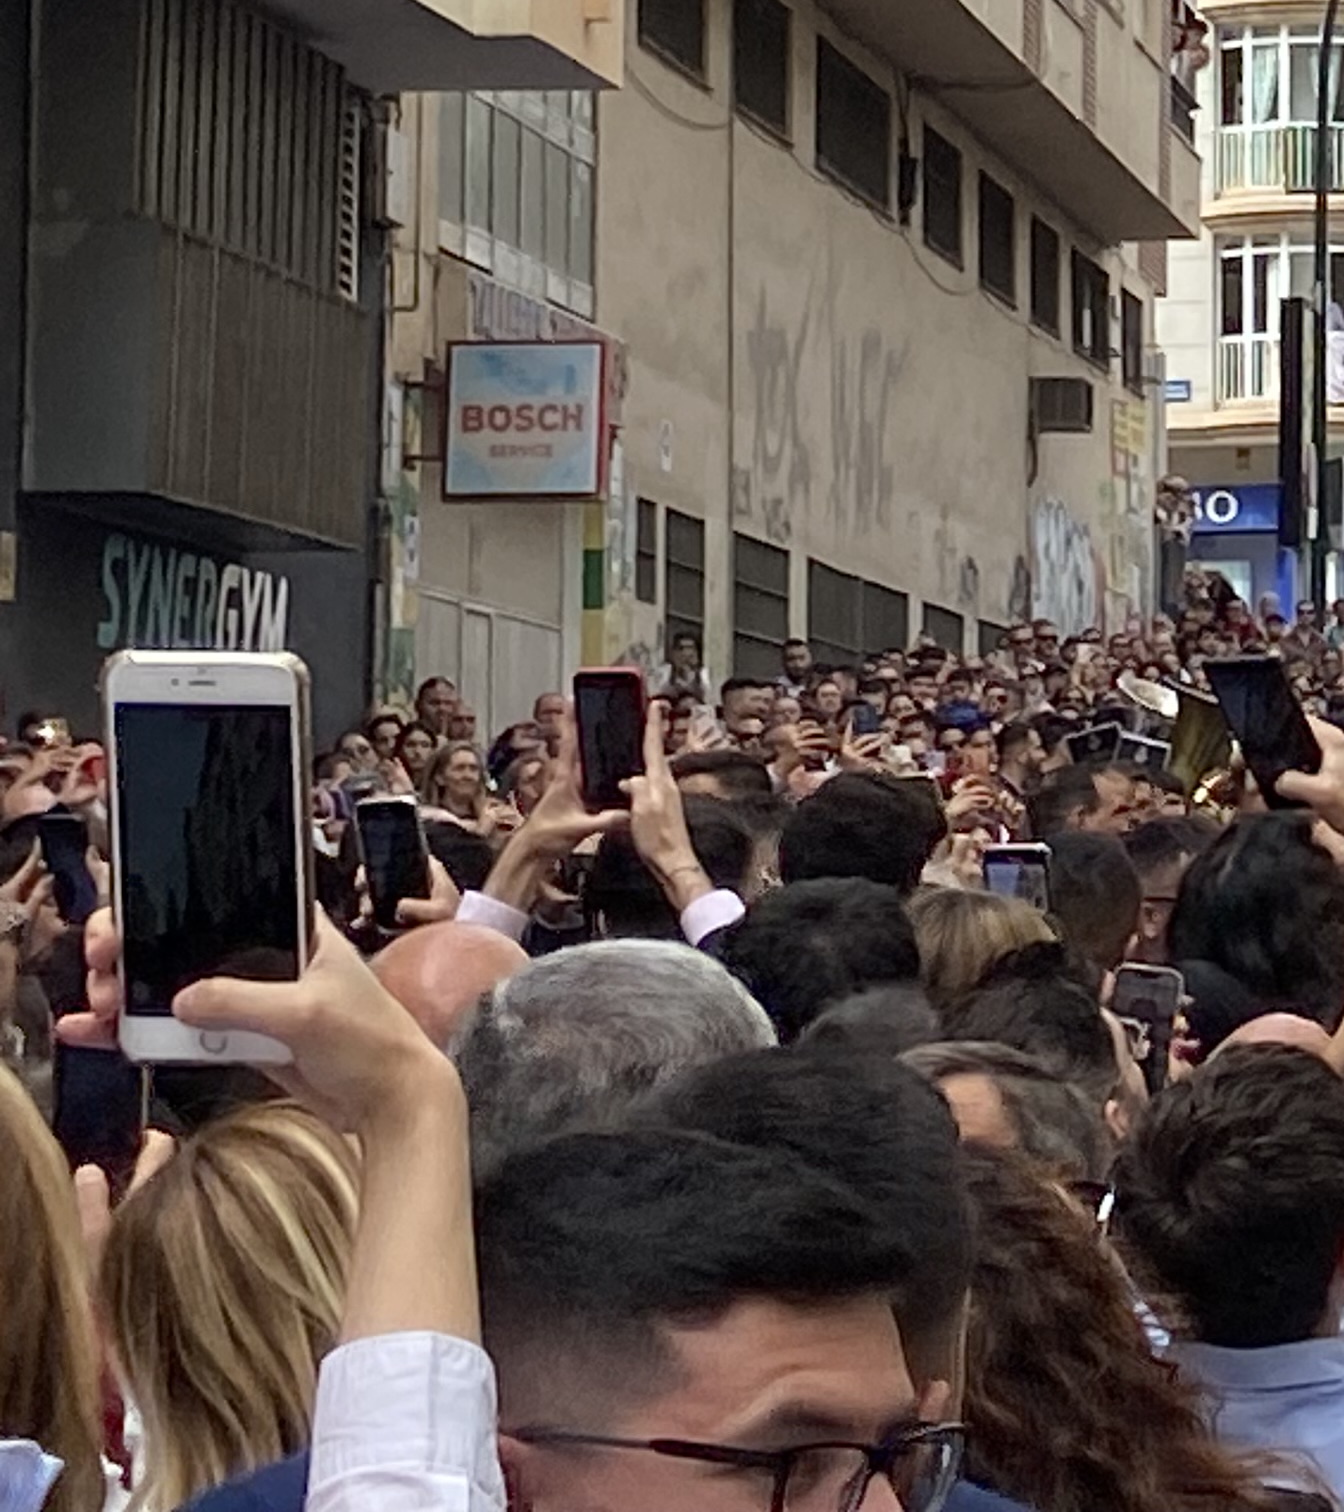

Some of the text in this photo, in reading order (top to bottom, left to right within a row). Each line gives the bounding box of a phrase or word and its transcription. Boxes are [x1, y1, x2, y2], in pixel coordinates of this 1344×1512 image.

[461, 403, 585, 433] BOSCH
[489, 444, 554, 458] SERVICE
[97, 534, 289, 652] SYNERGYM
